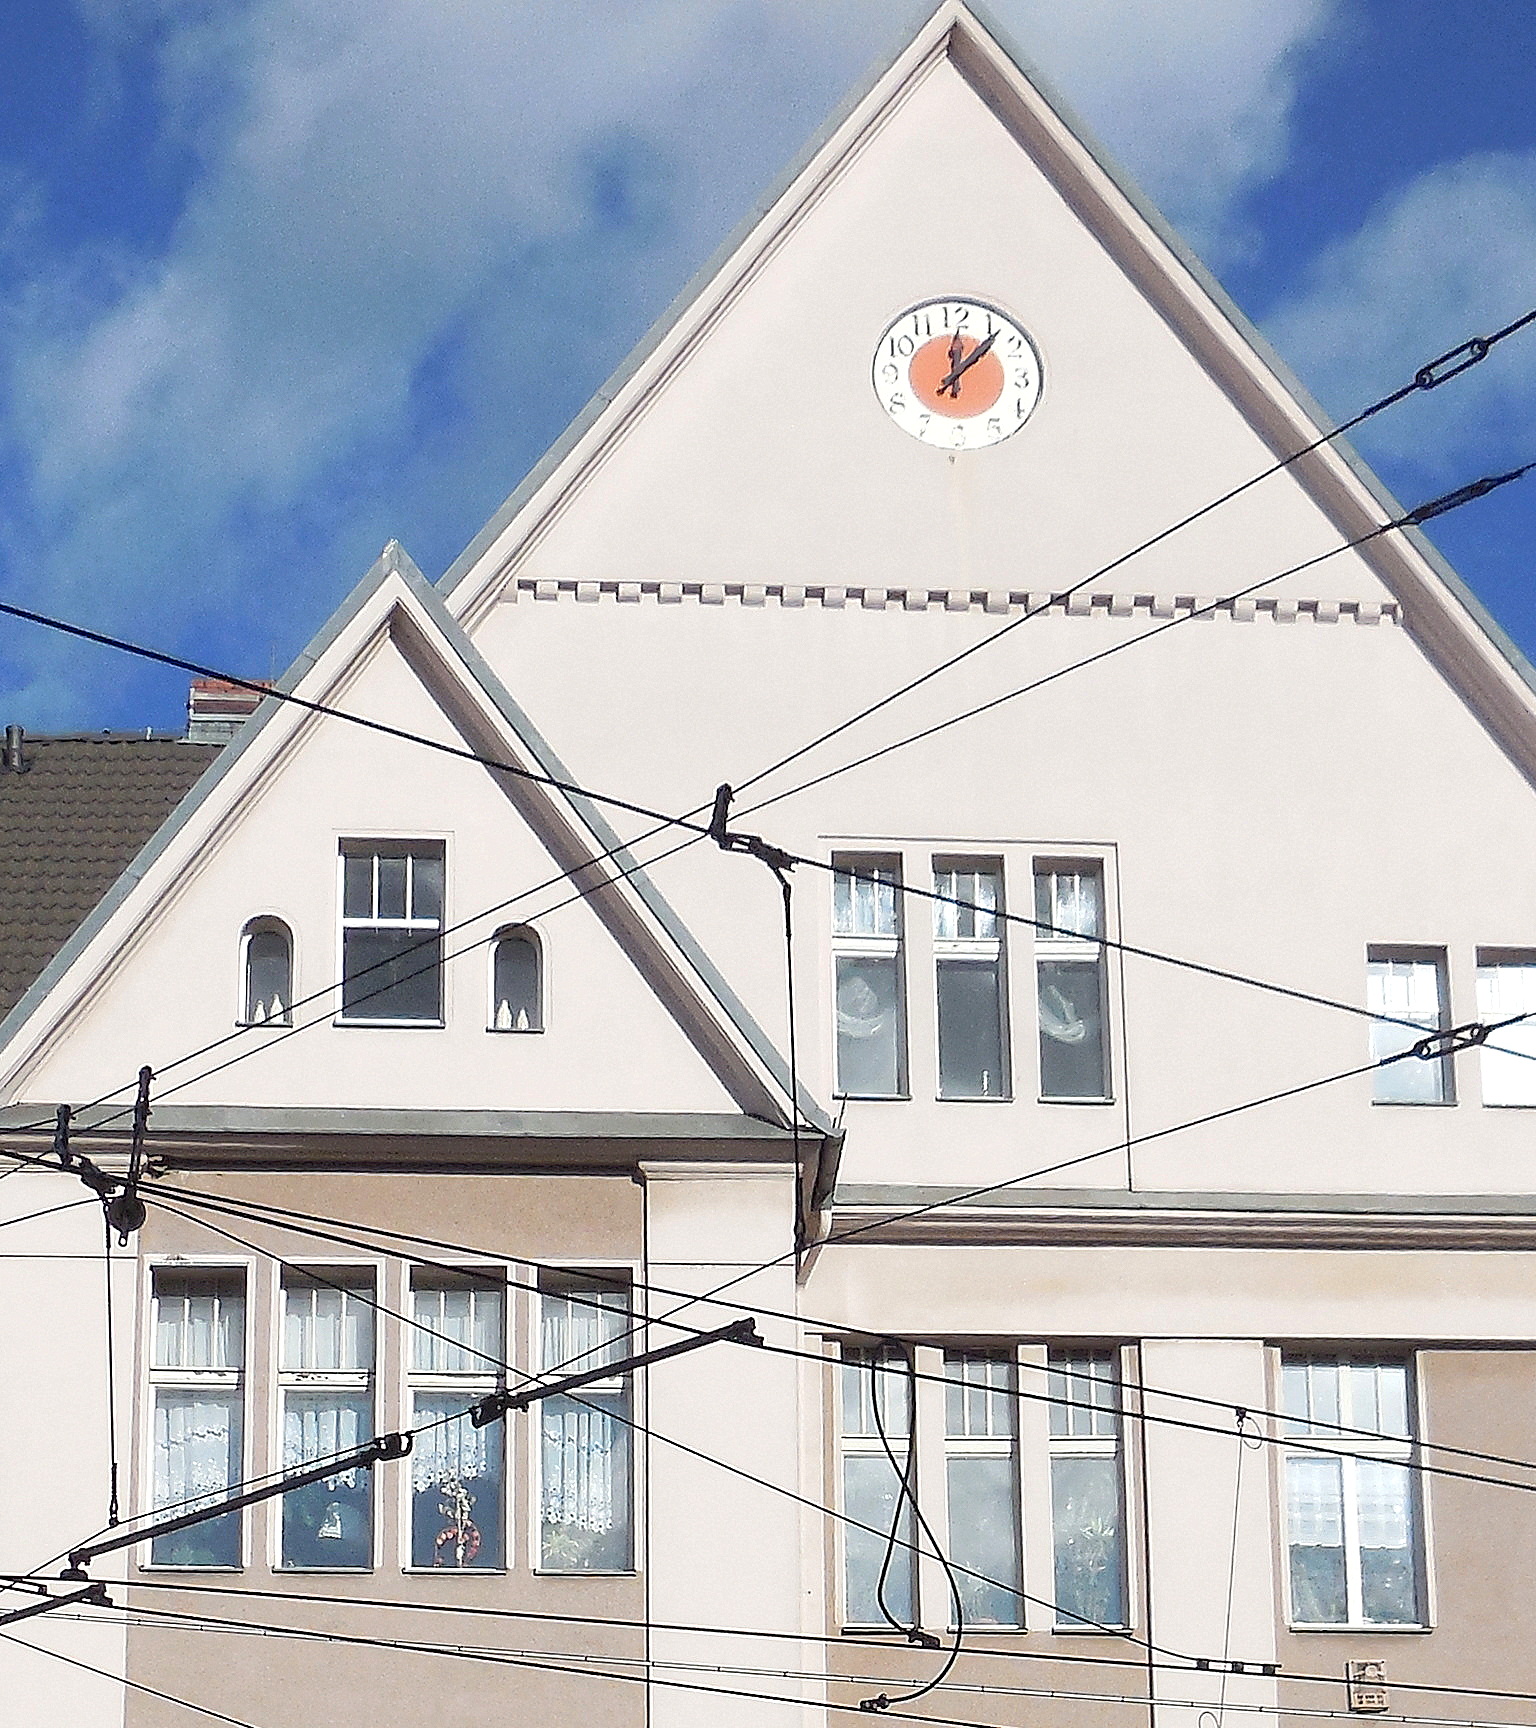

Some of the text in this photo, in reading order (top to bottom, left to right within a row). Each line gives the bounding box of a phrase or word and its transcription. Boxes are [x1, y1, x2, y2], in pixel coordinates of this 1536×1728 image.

[912, 313, 932, 337] 11
[943, 306, 969, 329] 12
[889, 335, 915, 358] 10
[1007, 335, 1023, 358] 2
[882, 362, 899, 384] 9
[1014, 366, 1030, 389] 3
